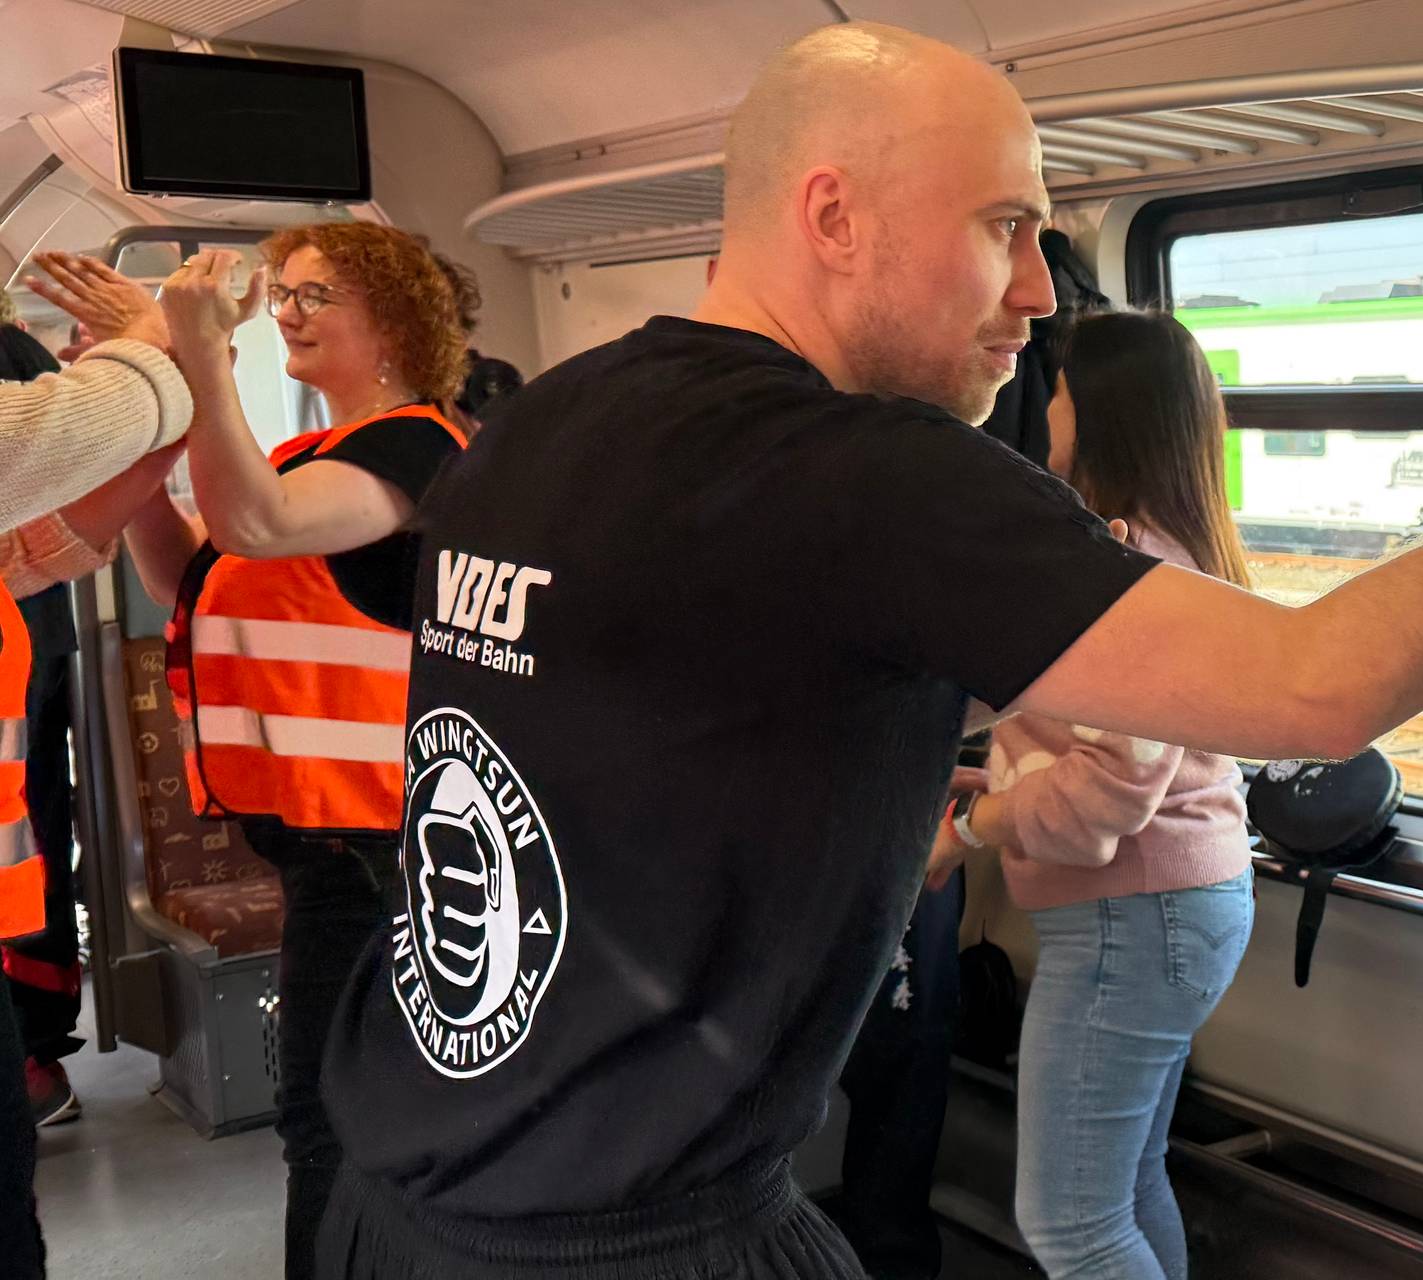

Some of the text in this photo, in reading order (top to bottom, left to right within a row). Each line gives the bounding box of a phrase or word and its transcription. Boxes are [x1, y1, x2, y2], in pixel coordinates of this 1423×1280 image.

[420, 618, 535, 676] Sport der Bahn
[437, 549, 552, 642] VDES
[416, 719, 540, 850] WINGTSUN
[392, 912, 539, 1066] INTERNATIONAL
